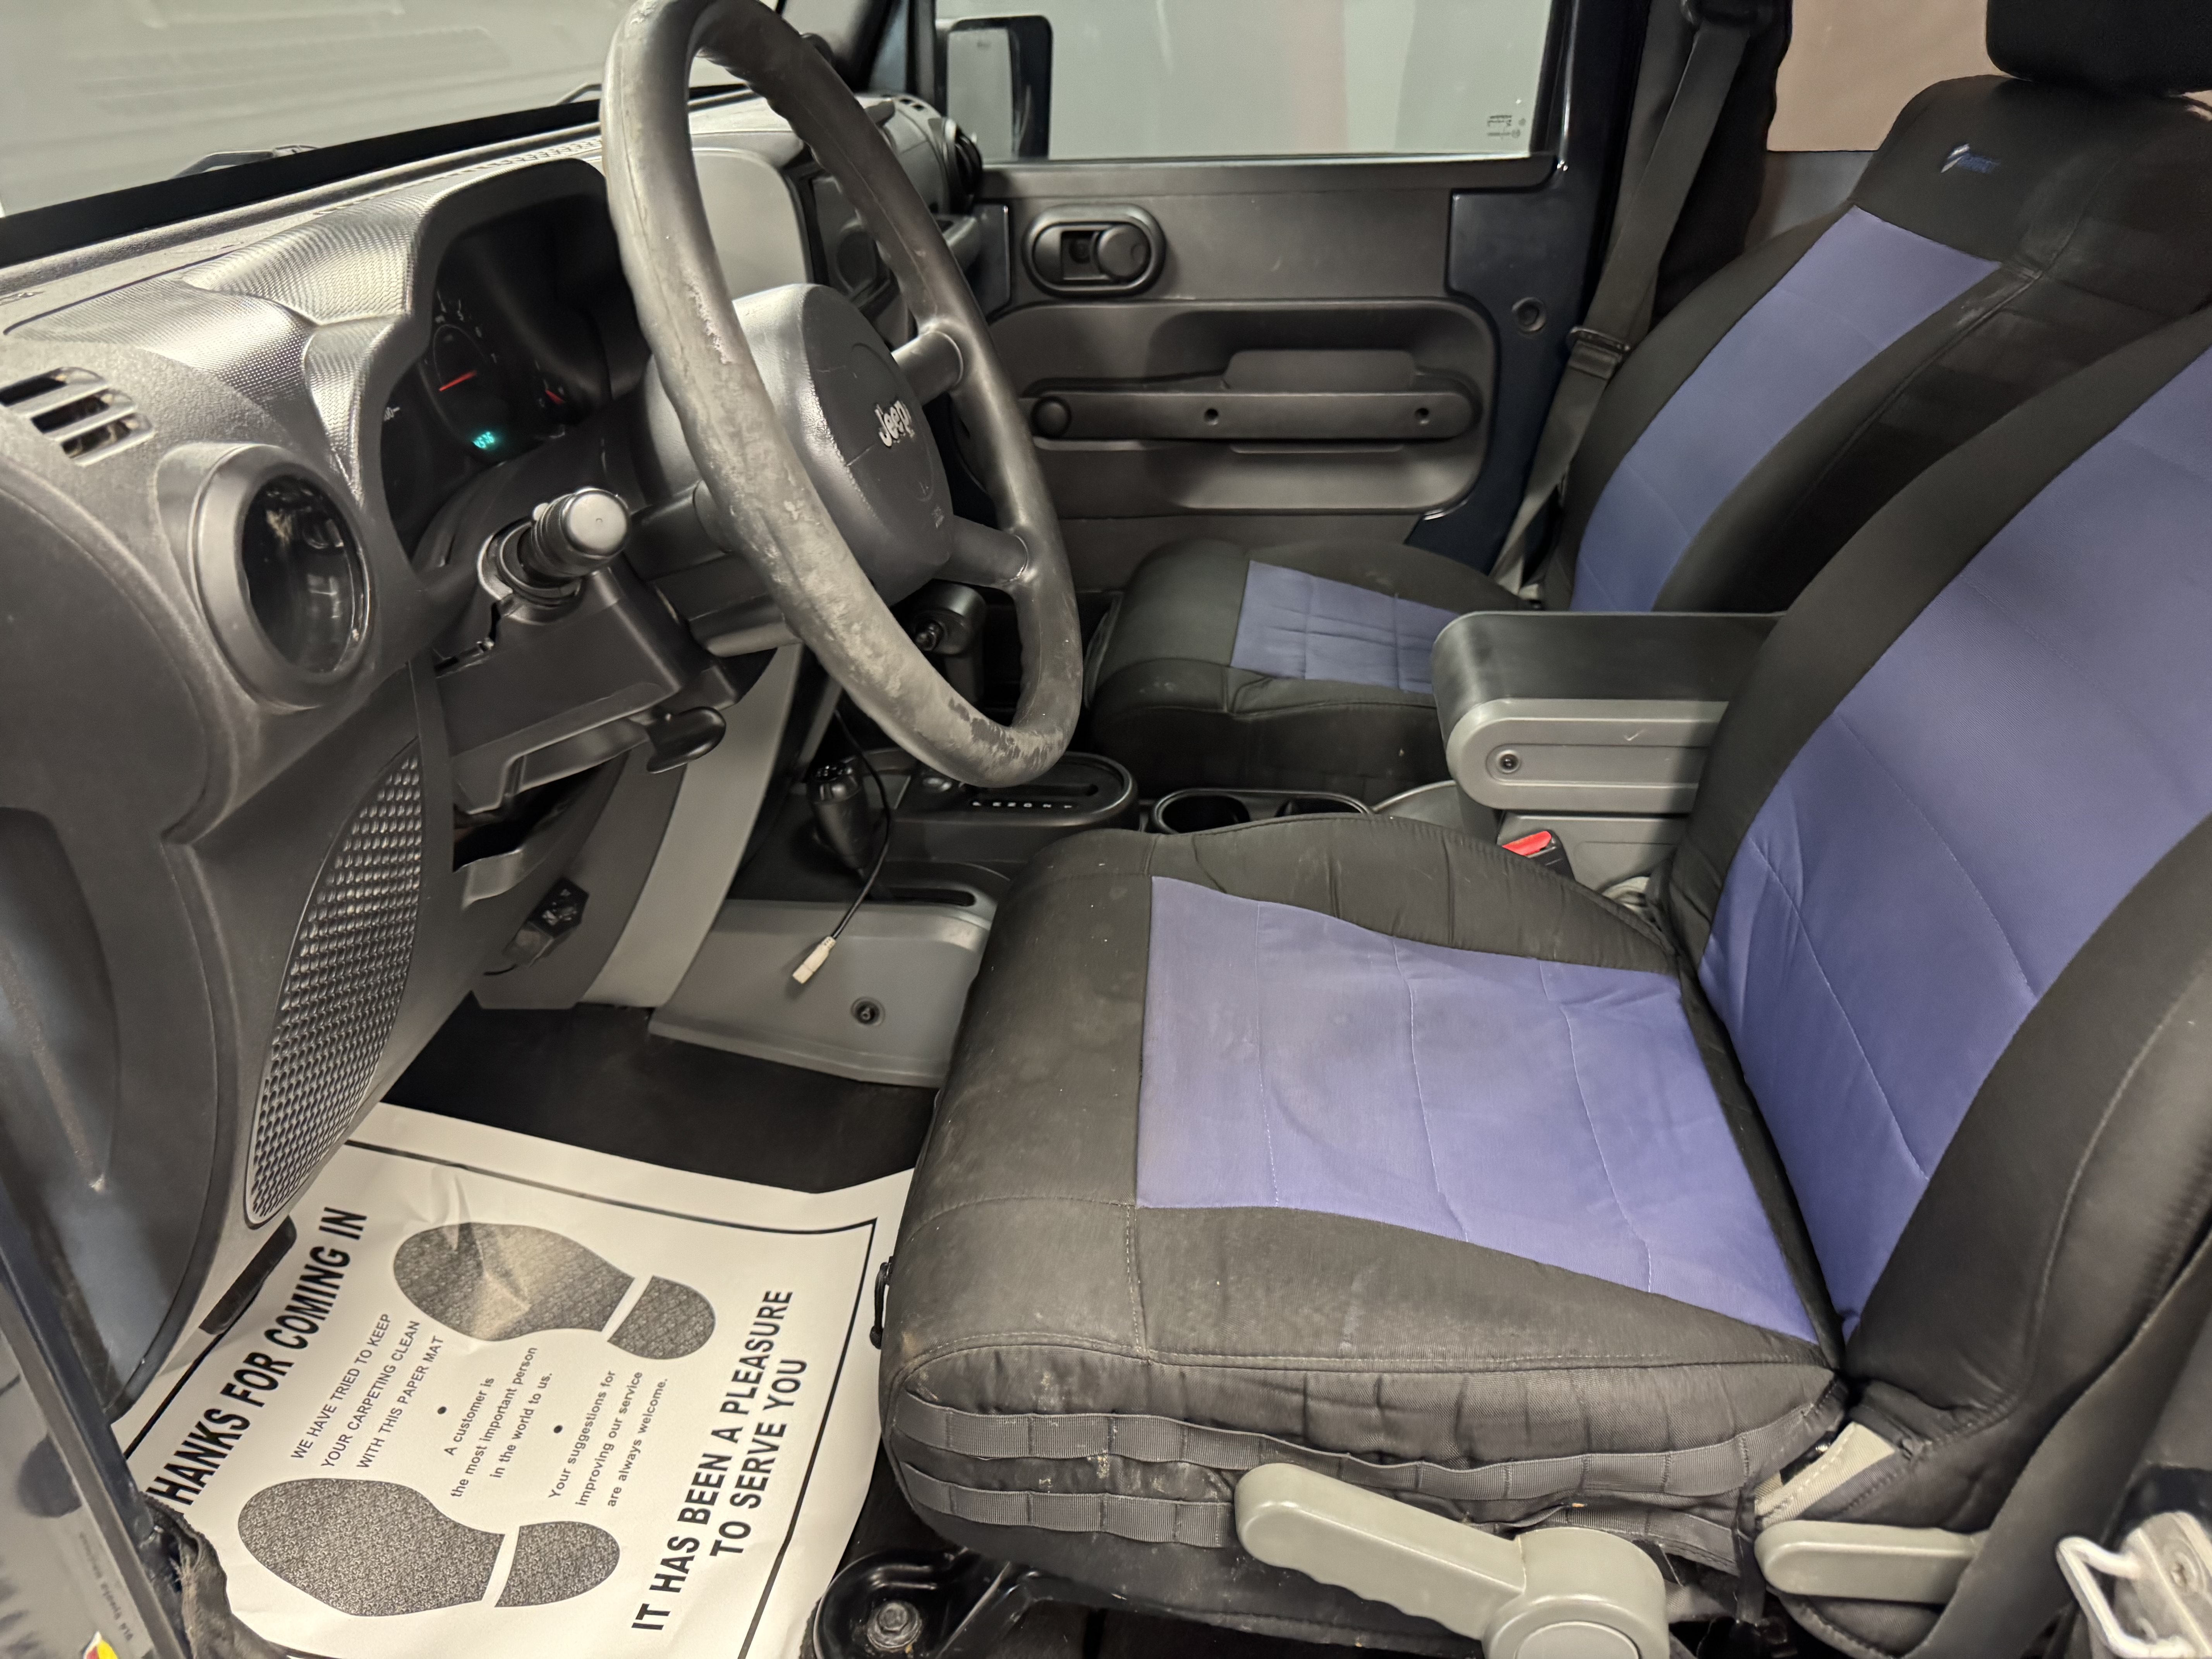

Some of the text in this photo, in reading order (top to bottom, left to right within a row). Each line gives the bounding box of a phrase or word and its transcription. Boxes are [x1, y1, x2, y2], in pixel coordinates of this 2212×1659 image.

[874, 400, 914, 447] Jeep
[146, 1207, 367, 1506] HANKS FOR COMING IN
[291, 1314, 390, 1458] WE HAVE TRIED TO KEEP
[321, 1321, 420, 1466] YOUR CARPETING CLEAN
[356, 1336, 443, 1467] WITH THIS PAPER MAT
[444, 1379, 494, 1455] A customer is
[451, 1348, 537, 1497] the most important person
[489, 1374, 552, 1478] in the world to us.
[548, 1371, 615, 1498] Your suggestions for
[575, 1372, 642, 1505] improving our service
[608, 1378, 668, 1506] are always welcome.
[631, 1291, 793, 1630] IT HAS BEEN A PLEASURE
[709, 1360, 807, 1556] TO SERVE YOU
